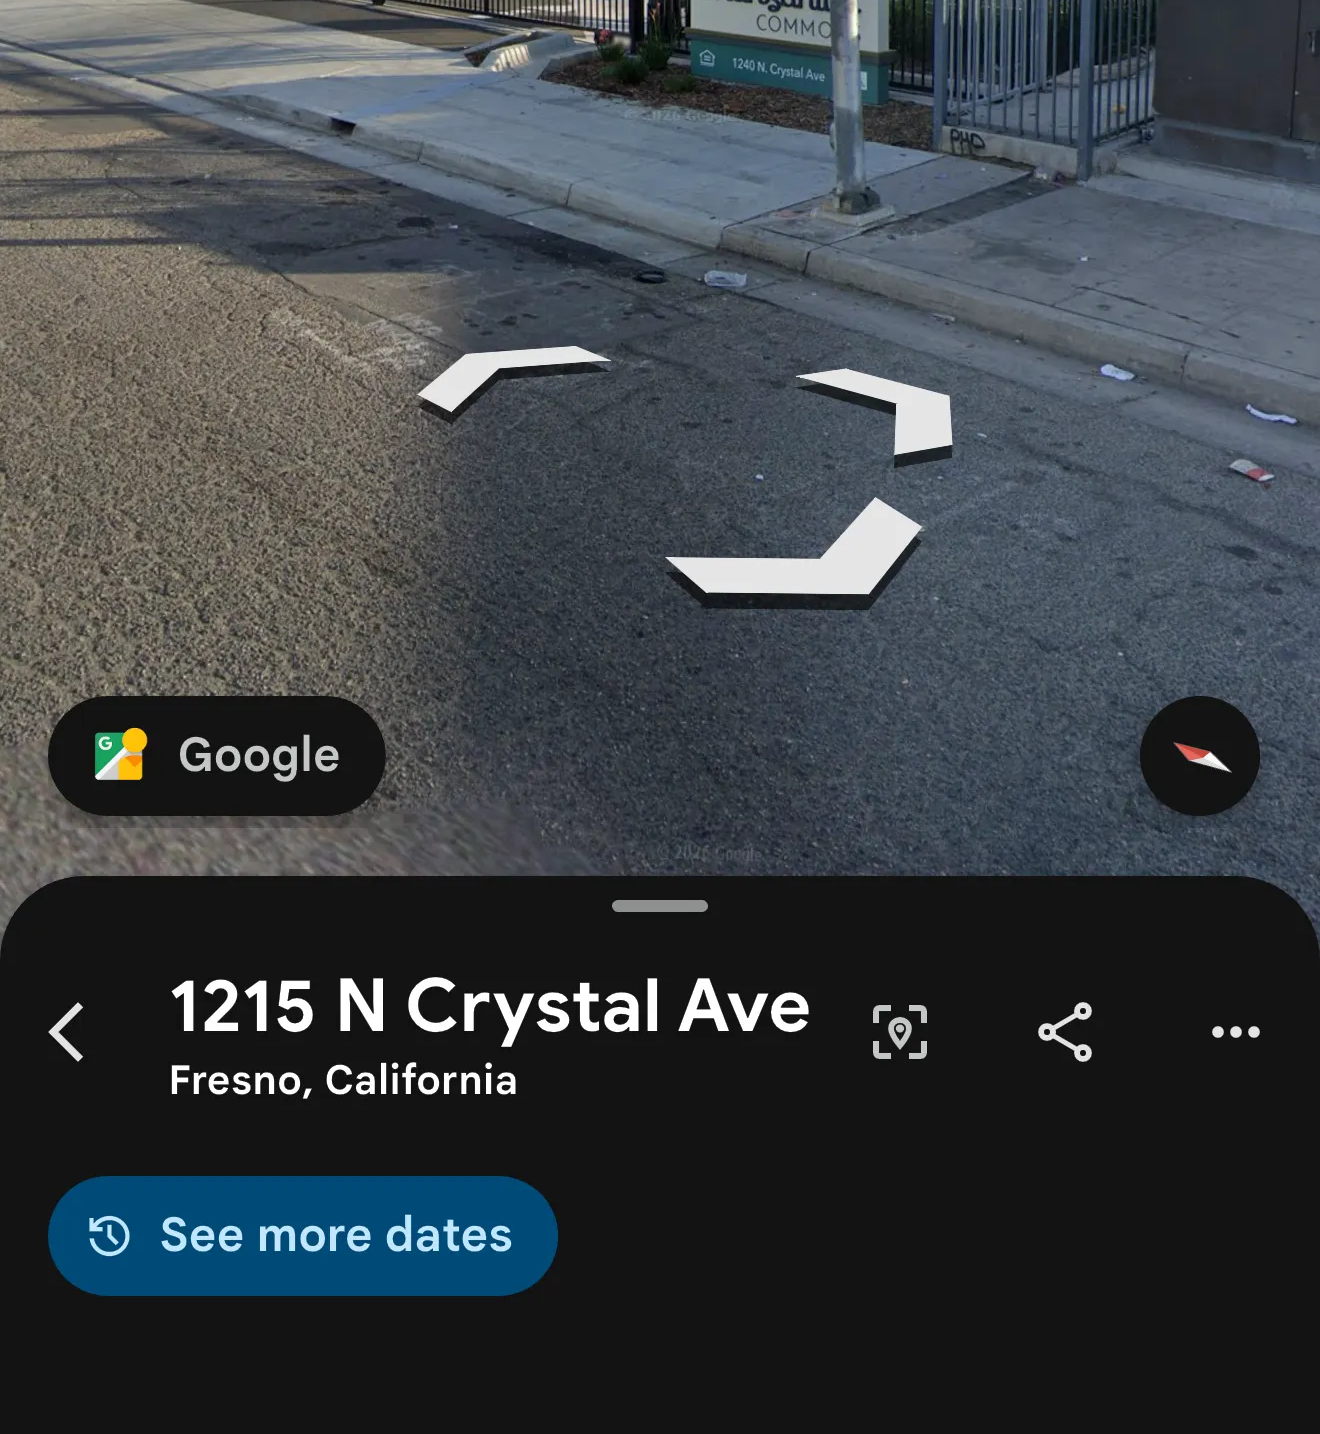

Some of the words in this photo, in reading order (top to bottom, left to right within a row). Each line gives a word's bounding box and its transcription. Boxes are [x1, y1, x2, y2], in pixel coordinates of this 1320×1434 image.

[756, 14, 861, 41] COMMO
[732, 57, 756, 72] 1240
[757, 61, 768, 74] N.
[769, 63, 804, 79] Crystal
[805, 68, 826, 82] Ave
